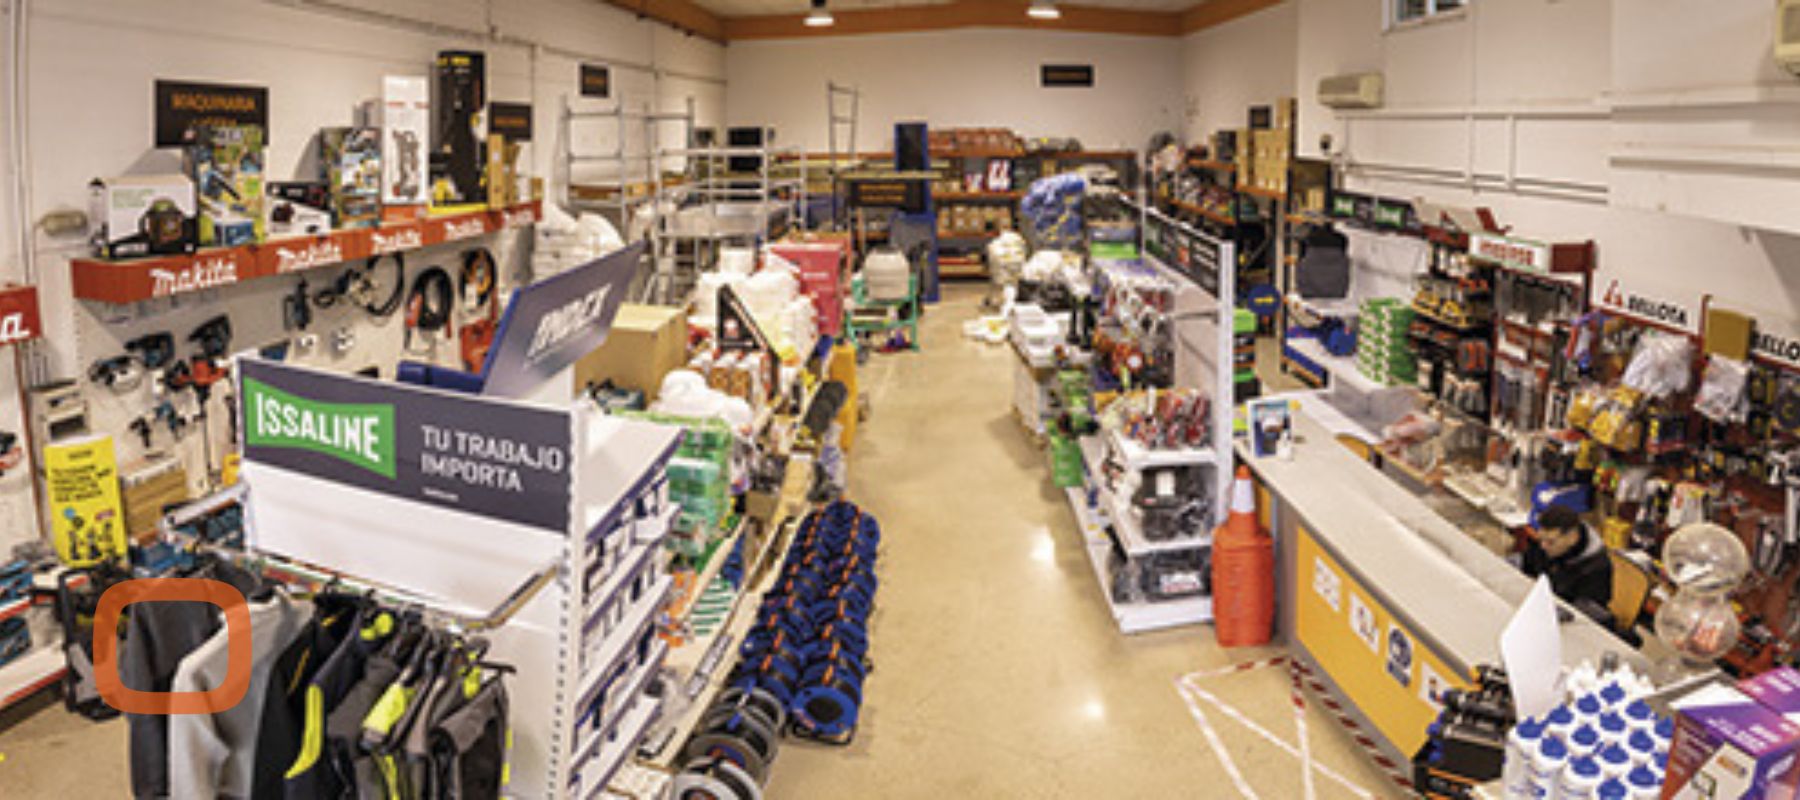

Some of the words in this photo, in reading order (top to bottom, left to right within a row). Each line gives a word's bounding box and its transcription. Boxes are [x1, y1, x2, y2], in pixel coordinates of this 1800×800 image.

[256, 392, 382, 463] ISSALINE
[421, 425, 450, 450] TU
[455, 432, 564, 473] TRABAJO
[420, 455, 522, 492] IMPORTA
